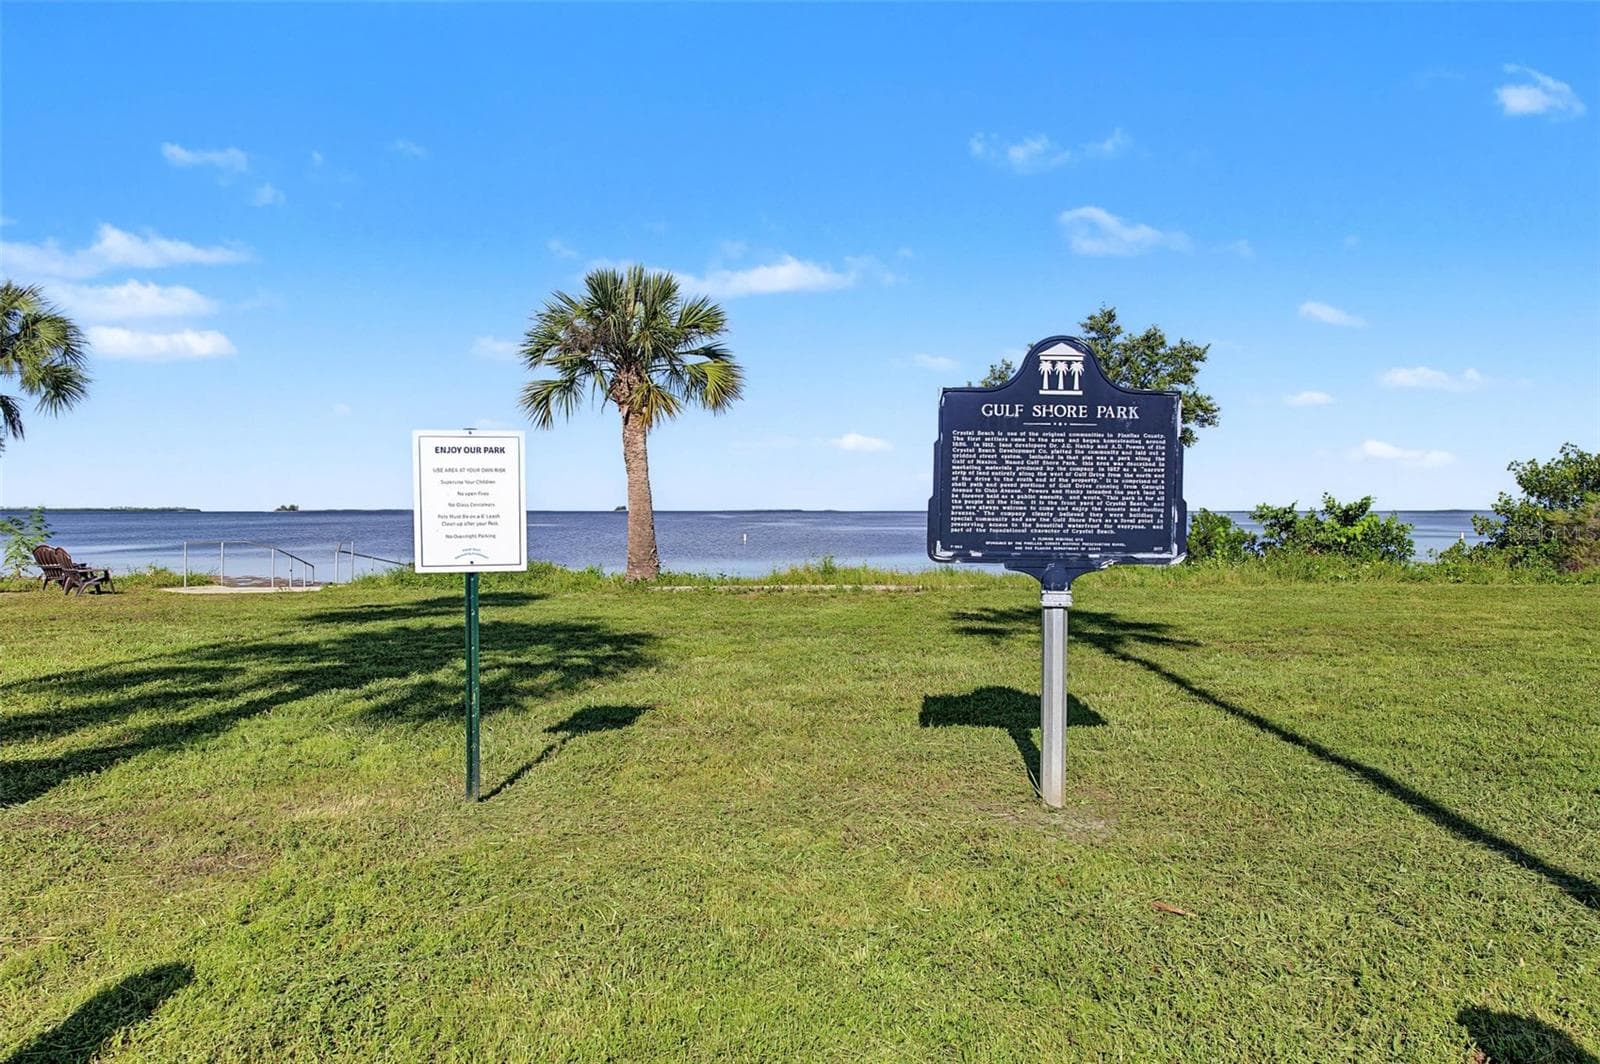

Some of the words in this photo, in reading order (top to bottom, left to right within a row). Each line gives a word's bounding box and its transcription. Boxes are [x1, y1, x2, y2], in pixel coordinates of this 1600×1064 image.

[981, 404, 1024, 417] GULF
[1032, 404, 1088, 418] SHORE
[1096, 405, 1140, 419] PARK
